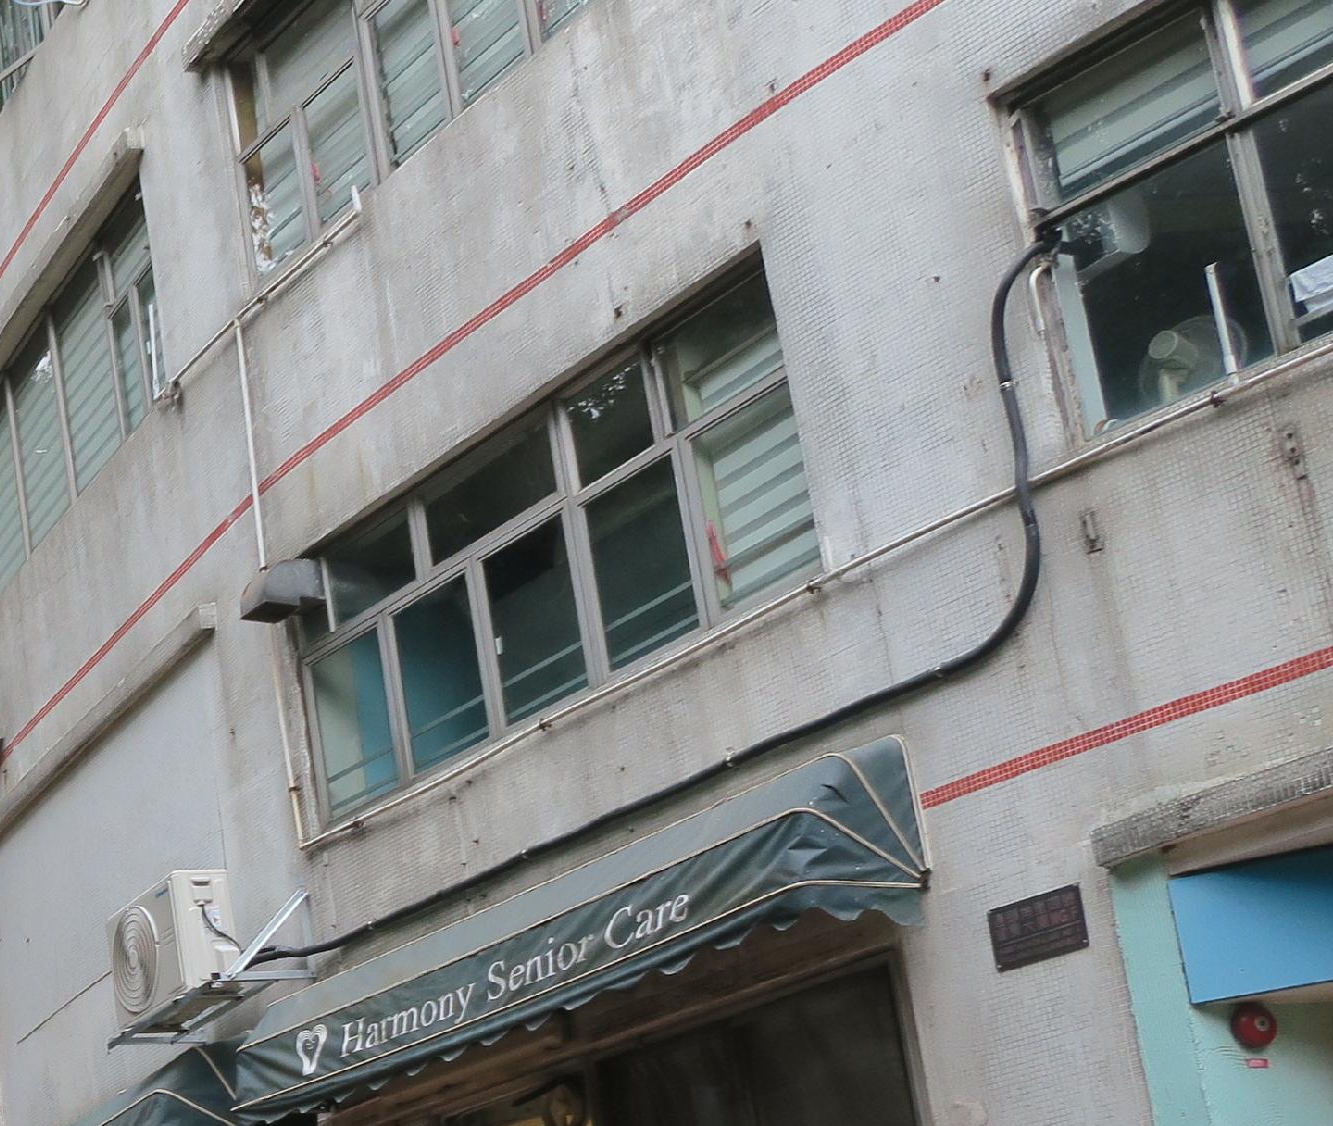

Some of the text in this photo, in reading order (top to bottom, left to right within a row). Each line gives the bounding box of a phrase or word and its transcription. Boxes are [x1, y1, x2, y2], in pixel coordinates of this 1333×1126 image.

[339, 894, 690, 1058] Harmony Senior Care
